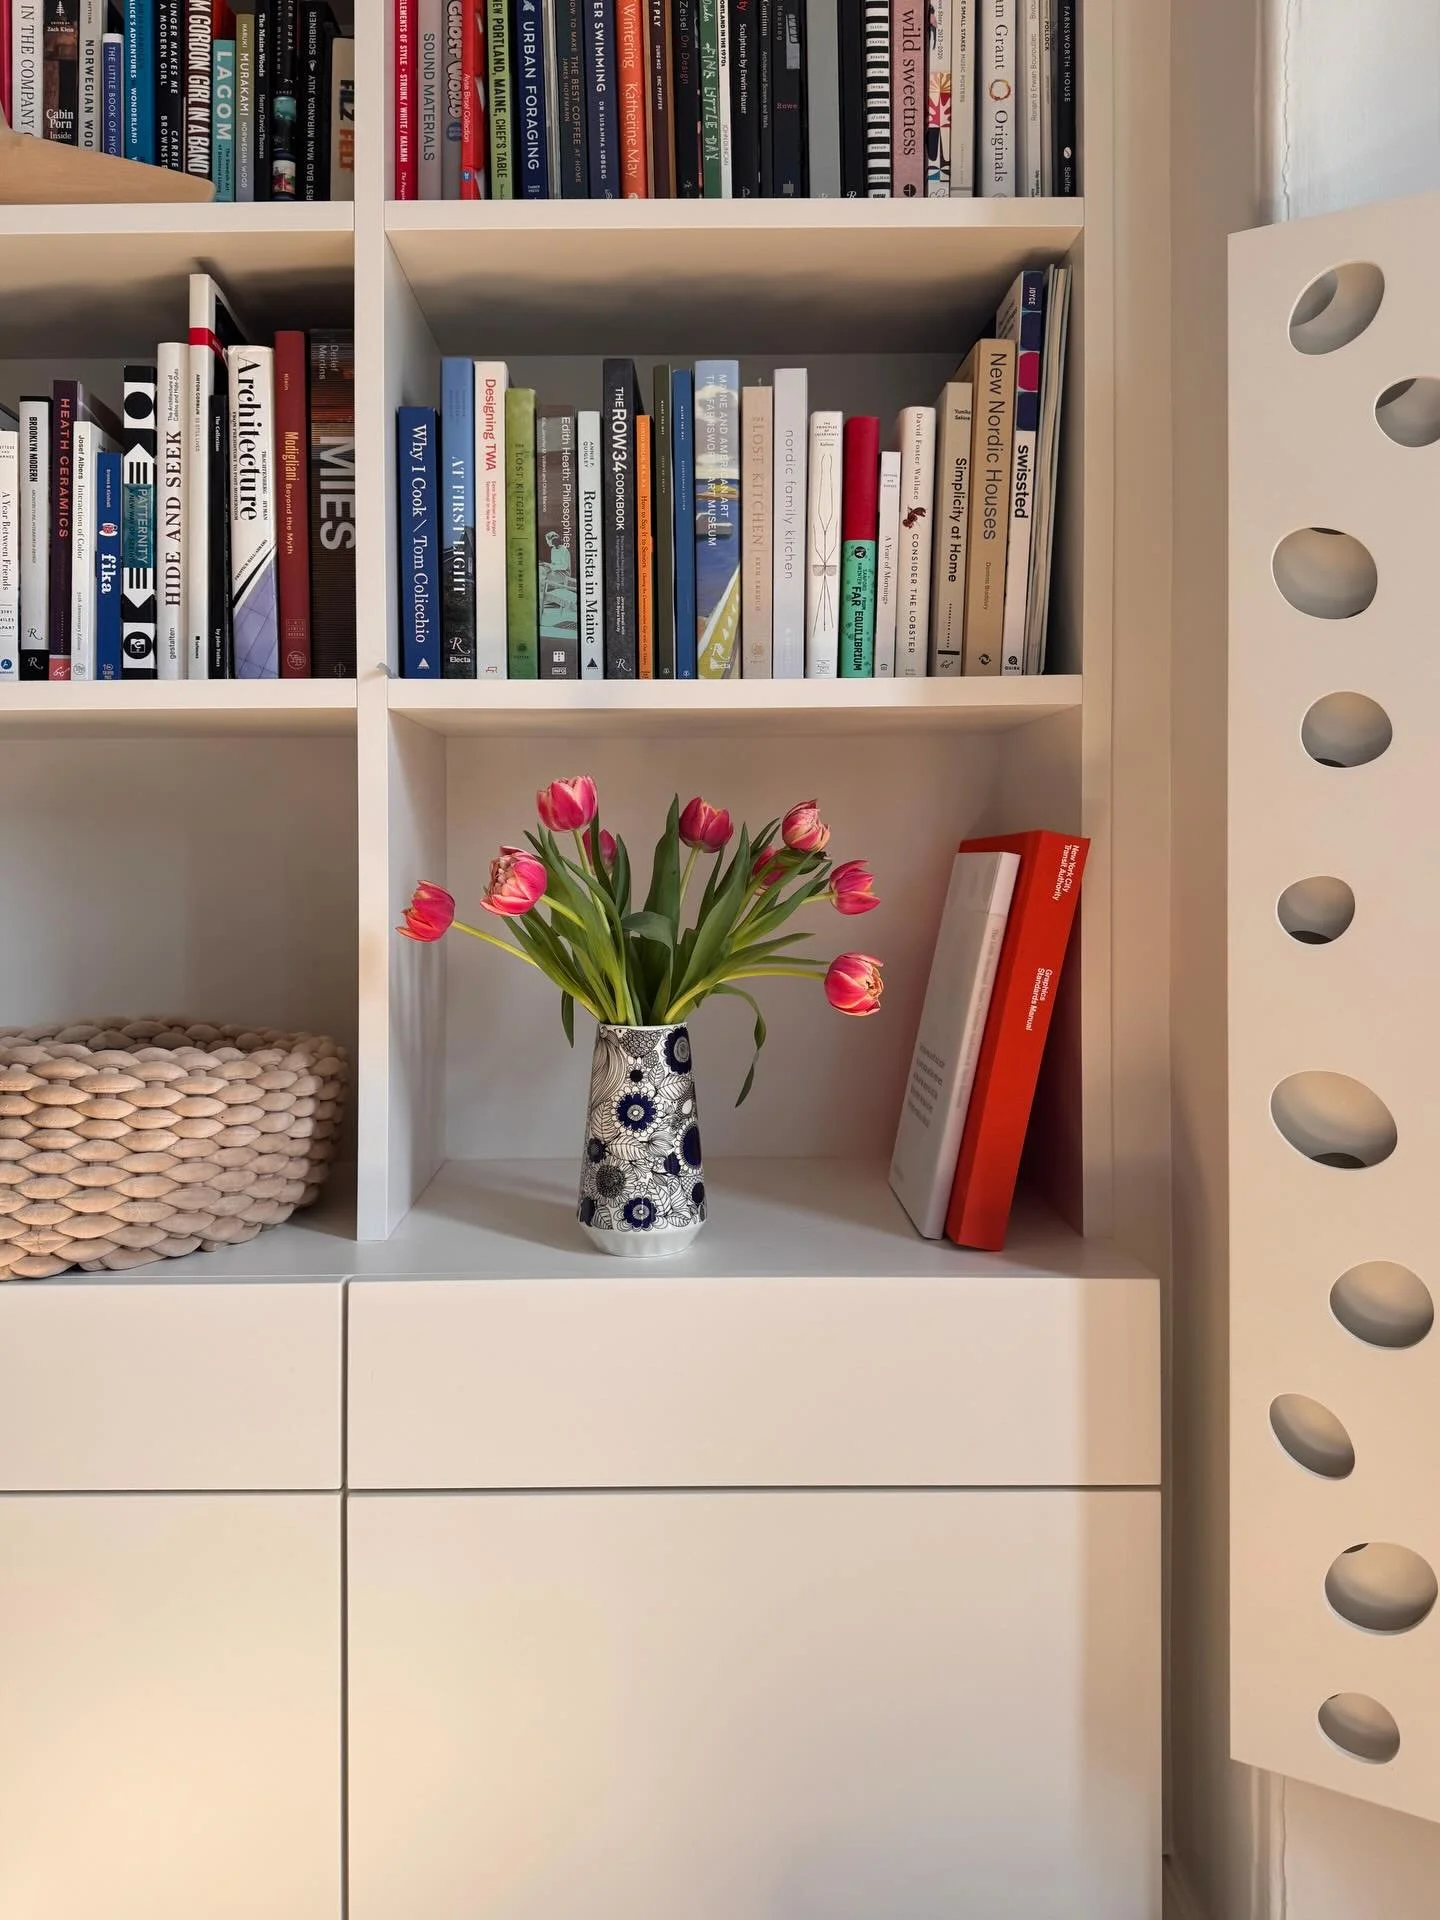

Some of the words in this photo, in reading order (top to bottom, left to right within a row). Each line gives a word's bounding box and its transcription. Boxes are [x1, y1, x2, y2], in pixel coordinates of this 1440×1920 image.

[21, 5, 34, 20] IN
[258, 13, 266, 28] The
[399, 0, 408, 33] ELEMENTS
[21, 25, 34, 54] THE
[188, 14, 211, 72] GORDON
[258, 29, 266, 52] Maine
[309, 11, 318, 55] SCRIBNER
[399, 34, 408, 43] OF
[622, 4, 638, 69] Wintering
[737, 23, 747, 59] Sculpture
[902, 9, 921, 53] wild
[994, 24, 1008, 70] Grant
[1063, 6, 1071, 68] FARNSWORTH
[108, 46, 116, 62] THE
[258, 54, 266, 78] Woods
[400, 45, 408, 65] STYLE
[423, 33, 435, 80] SOUND
[523, 20, 537, 78] URBAN
[594, 22, 606, 93] SWIMMING
[738, 59, 747, 68] by
[20, 59, 34, 129] COMPANY
[108, 65, 116, 89] LITTLE
[188, 74, 211, 105] GIRL
[240, 53, 249, 117] MURAKAMI
[308, 75, 316, 94] JULY
[399, 74, 408, 101] STRUNK
[740, 69, 748, 90] Erwin
[108, 93, 116, 118] BOOK
[216, 50, 232, 141] LAGOM
[257, 94, 266, 113] Henry
[740, 91, 748, 114] Hauer
[902, 58, 918, 156] sweetness
[46, 109, 74, 120] Cabin
[49, 119, 72, 129] Porn
[108, 120, 116, 133] OF
[188, 107, 210, 123] IN
[188, 124, 210, 134] A
[258, 115, 266, 132] David
[308, 97, 316, 138] MIRANDA
[399, 107, 408, 129] WHITE
[423, 84, 435, 161] MATERIALS
[525, 86, 539, 171] FORAGING
[624, 82, 640, 147] Katherine
[50, 131, 72, 140] Inside
[258, 134, 266, 160] Thoreau
[307, 141, 315, 161] MAN
[400, 136, 408, 163] KALMAN
[990, 110, 1009, 183] Originals
[187, 136, 210, 174] BAND
[624, 149, 639, 178] May
[306, 164, 315, 182] BAD
[1028, 287, 1036, 305] JOYCE
[319, 345, 329, 380] Mertins
[989, 352, 1008, 394] New
[482, 378, 497, 440] Designing
[615, 387, 624, 407] THE
[29, 416, 38, 452] BROOKLYN
[60, 398, 71, 450] HEATH
[237, 356, 263, 521] Architecture
[561, 416, 572, 445] Edith
[611, 408, 627, 473] ROW34
[915, 413, 923, 437] David
[986, 400, 1006, 463] Nordic
[282, 431, 299, 481] Modigliani
[409, 423, 428, 461] Why
[485, 443, 497, 471] TWA
[784, 430, 797, 475] nordic
[914, 440, 923, 465] Foster
[29, 453, 38, 482] MODERN
[165, 431, 181, 488] SEEK
[451, 456, 465, 479] AT
[515, 452, 524, 478] LOST
[561, 447, 572, 481] Heath:
[59, 456, 71, 538] CERAMICS
[285, 483, 294, 514] Beyond
[319, 435, 356, 550] MIES
[411, 477, 427, 517] Cook
[913, 467, 922, 500] Wallace
[949, 457, 968, 522] Simplicity
[1014, 444, 1031, 519] swissted
[1, 499, 10, 519] Year
[77, 485, 85, 526] Interaction
[452, 485, 466, 535] FIRST
[515, 483, 525, 531] KITCHEN
[560, 484, 573, 548] Philosophies
[615, 473, 625, 531] COOKBOOK
[640, 496, 648, 511] How
[641, 511, 648, 519] to
[783, 481, 798, 524] family
[982, 469, 1003, 541] Houses
[77, 528, 85, 537] of
[137, 488, 148, 564] PATTERNITY
[165, 497, 181, 543] AND
[583, 490, 598, 579] Remodelista
[640, 519, 649, 532] Say
[951, 526, 961, 540] at
[1, 521, 11, 558] Between
[77, 538, 85, 560] Color
[285, 533, 294, 554] Myth
[413, 535, 428, 570] Tom
[784, 531, 798, 580] kitchen
[884, 544, 892, 560] Year
[101, 553, 116, 595] fika
[453, 540, 467, 596] LIGHT
[641, 546, 650, 569] Seniors
[884, 561, 892, 570] of
[910, 533, 920, 585] CONSIDER
[948, 544, 961, 583] Home
[1, 559, 11, 591] Friends
[165, 552, 181, 607] HIDE
[585, 582, 598, 596] in
[881, 571, 891, 605] Mornings
[413, 572, 430, 643] Colicchio
[851, 586, 862, 607] FAR
[909, 588, 918, 607] THE
[585, 599, 600, 644] Maine
[908, 610, 917, 654] LOBSTER
[169, 627, 177, 660] gestalten
[853, 611, 864, 671] EQUILIBRIUM
[1060, 844, 1073, 869] Transit
[1065, 860, 1077, 878] York
[1069, 845, 1080, 859] New
[1051, 868, 1065, 902] Authority
[1062, 878, 1073, 893] City
[1031, 967, 1045, 1006] Standards
[1039, 968, 1053, 1002] Graphics
[1025, 1005, 1038, 1032] Manual
